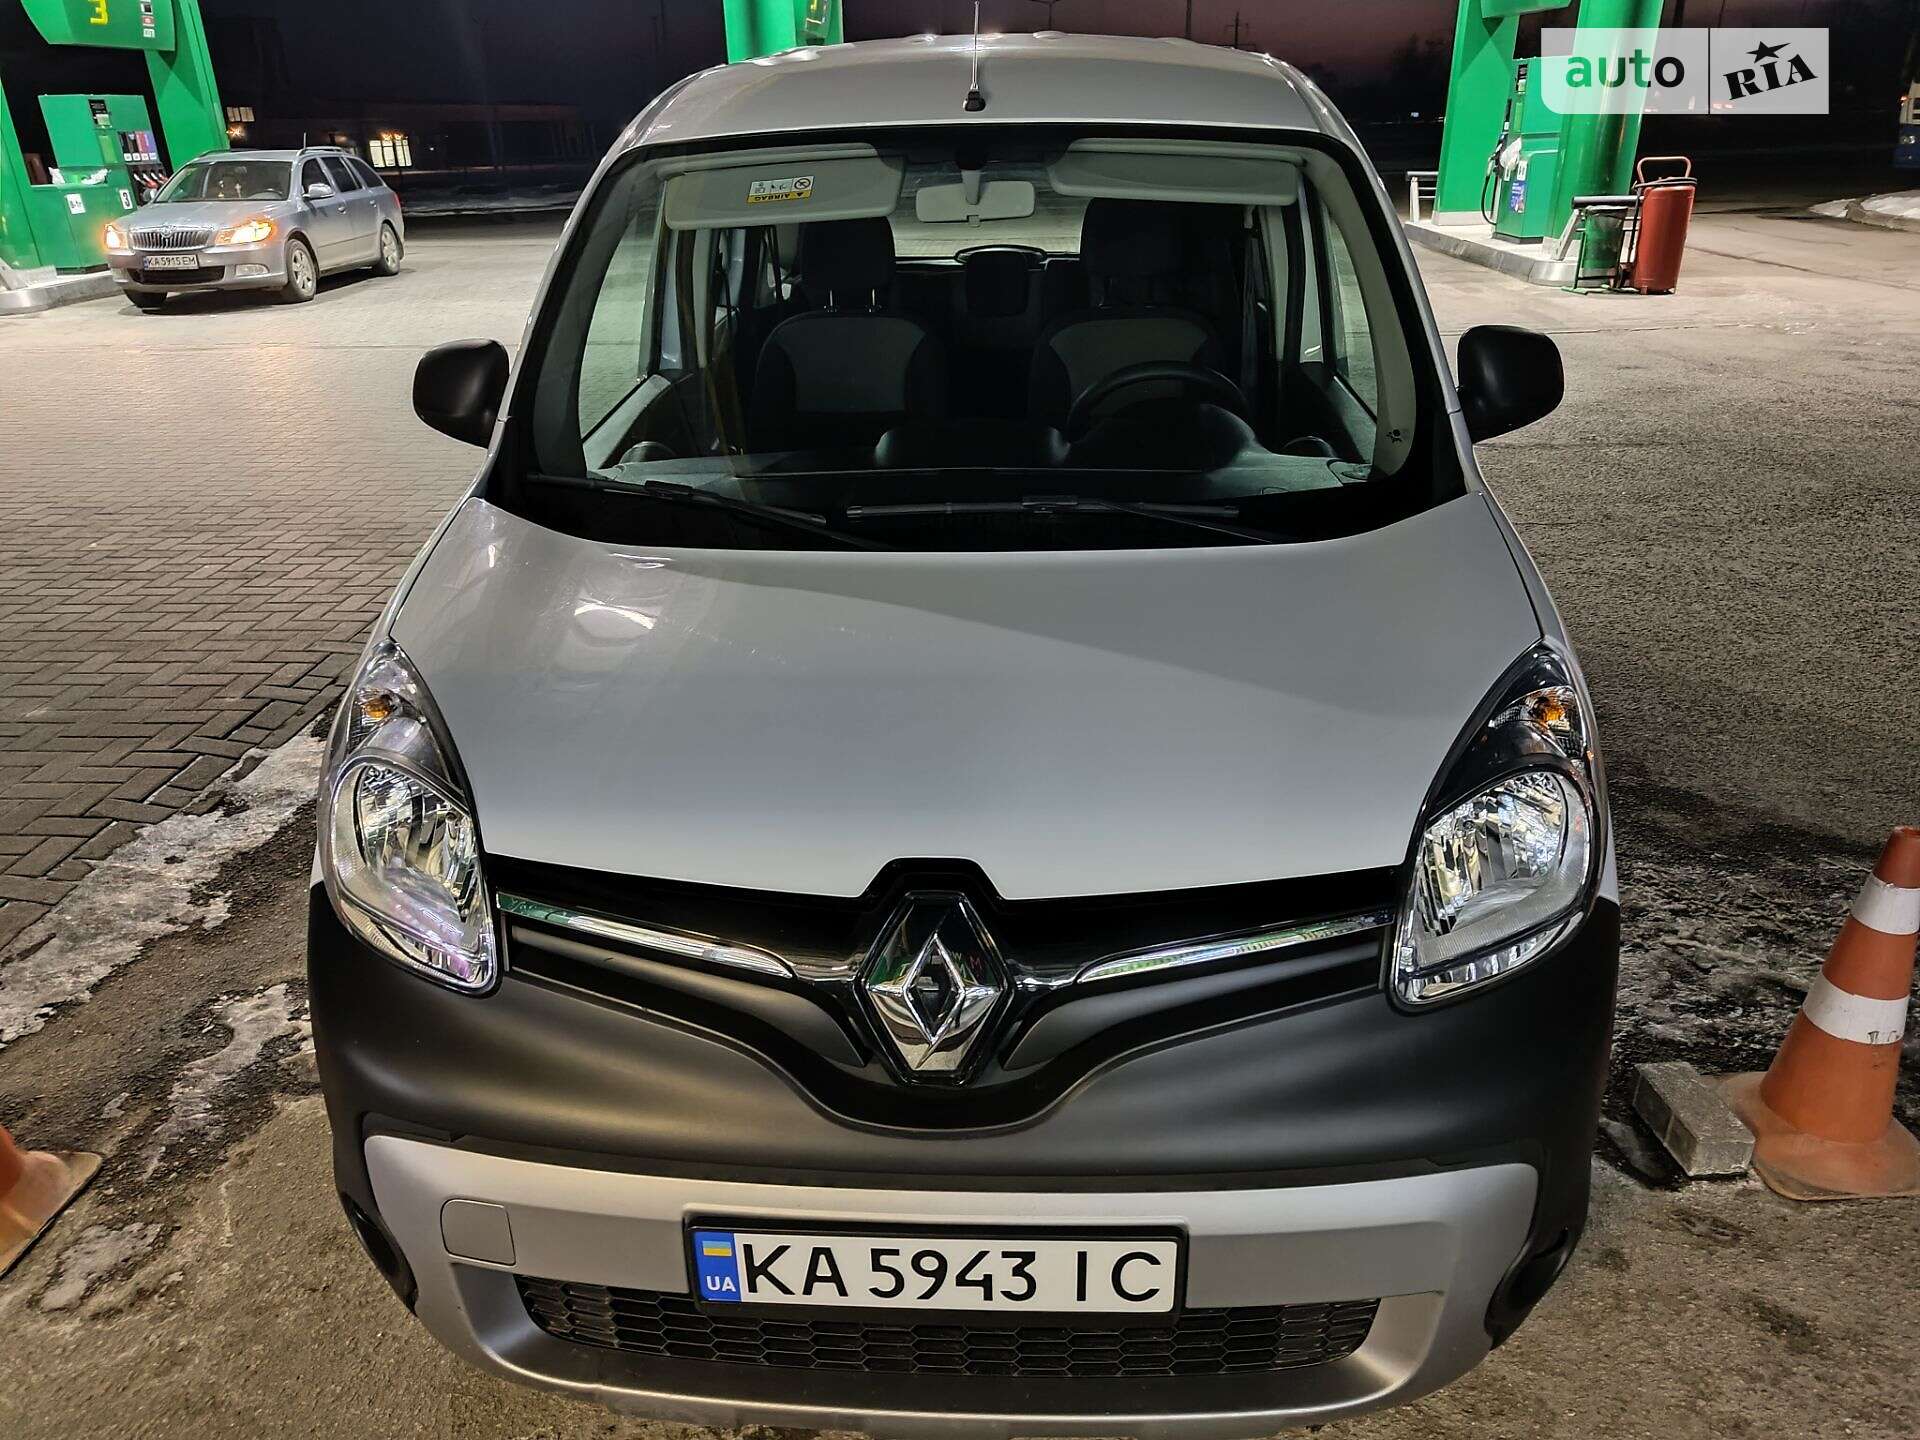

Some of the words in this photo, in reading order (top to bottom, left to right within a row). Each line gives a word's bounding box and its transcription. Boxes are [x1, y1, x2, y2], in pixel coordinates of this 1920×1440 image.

[122, 191, 131, 208] 3
[754, 193, 791, 202] AIRBAG
[742, 1243, 849, 1298] KA
[868, 1247, 1037, 1302] 5943
[1075, 1249, 1162, 1303] IC
[706, 1274, 737, 1293] UA
